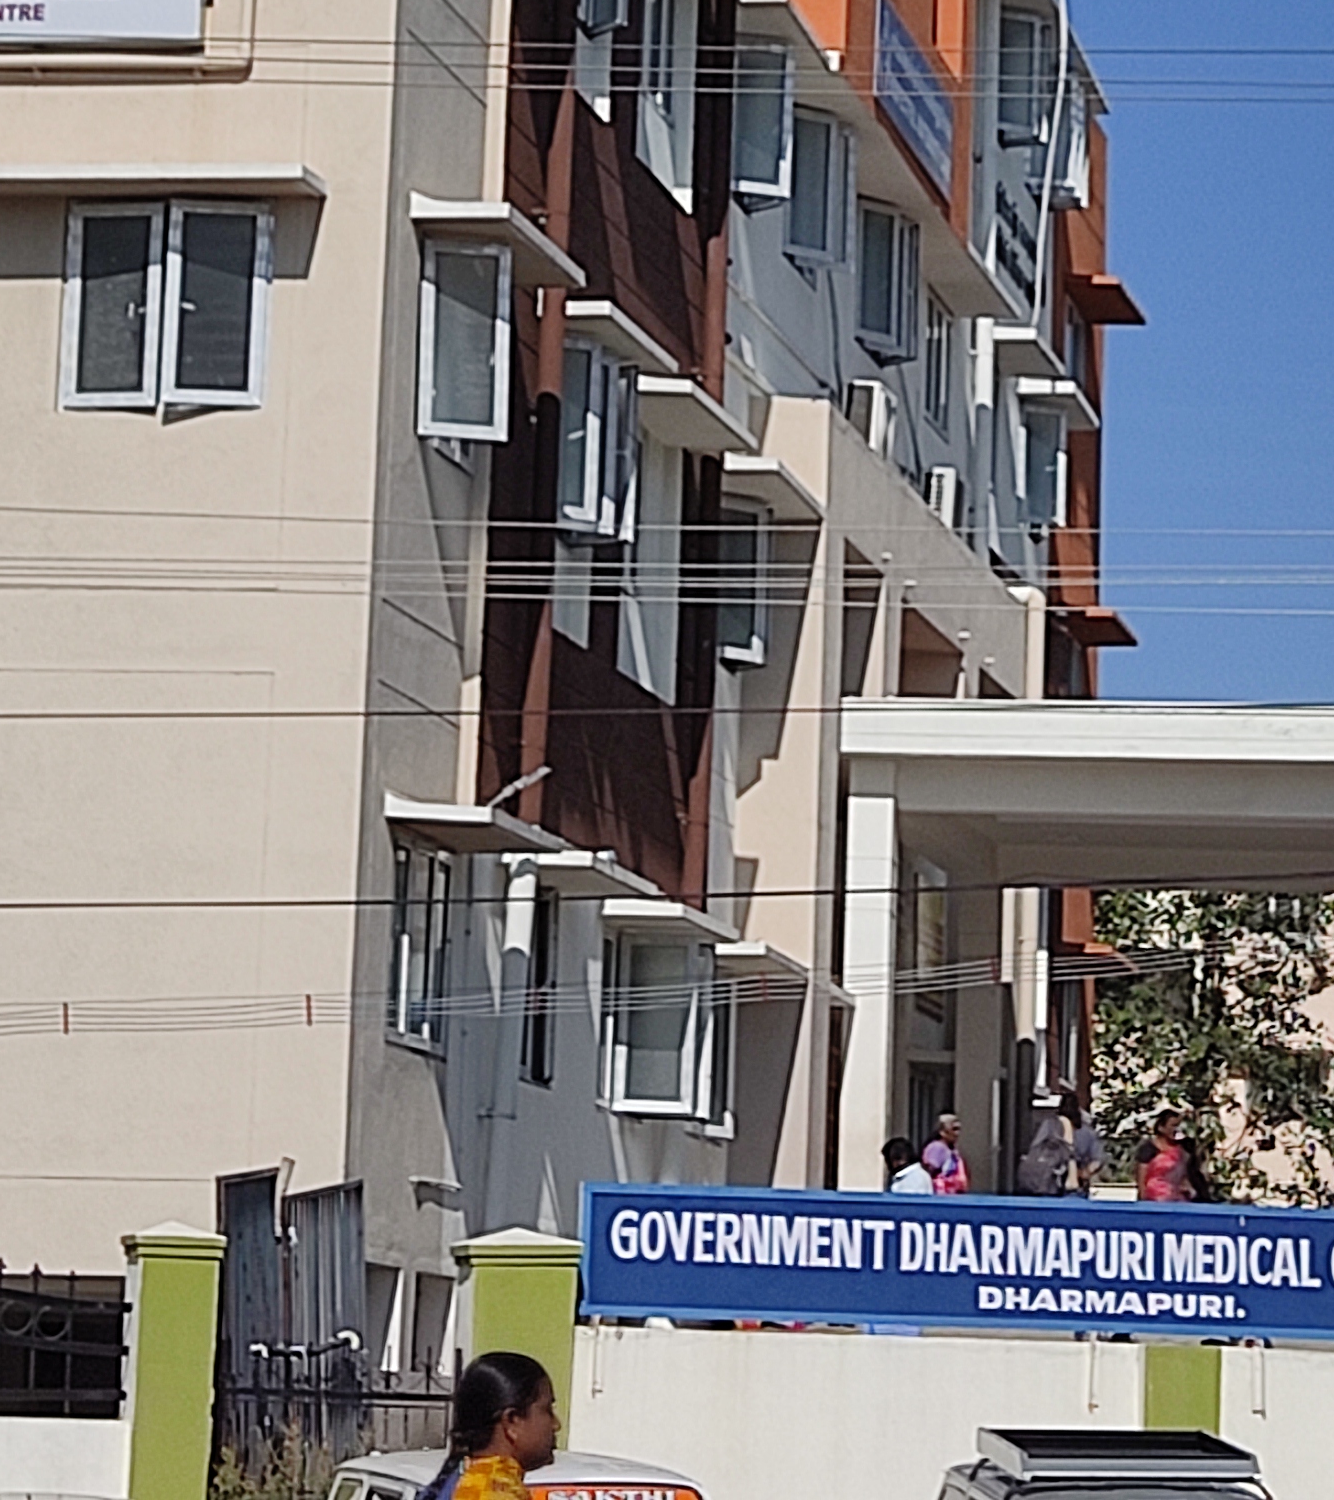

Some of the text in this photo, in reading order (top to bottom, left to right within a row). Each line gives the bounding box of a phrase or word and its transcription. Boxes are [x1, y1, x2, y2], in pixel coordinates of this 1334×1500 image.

[610, 1209, 895, 1271] GOVERNMENT
[899, 1220, 1155, 1283] DHARMAPURI
[1162, 1232, 1322, 1289] MEDICAL
[978, 1286, 1246, 1319] DHARMAPURI.
